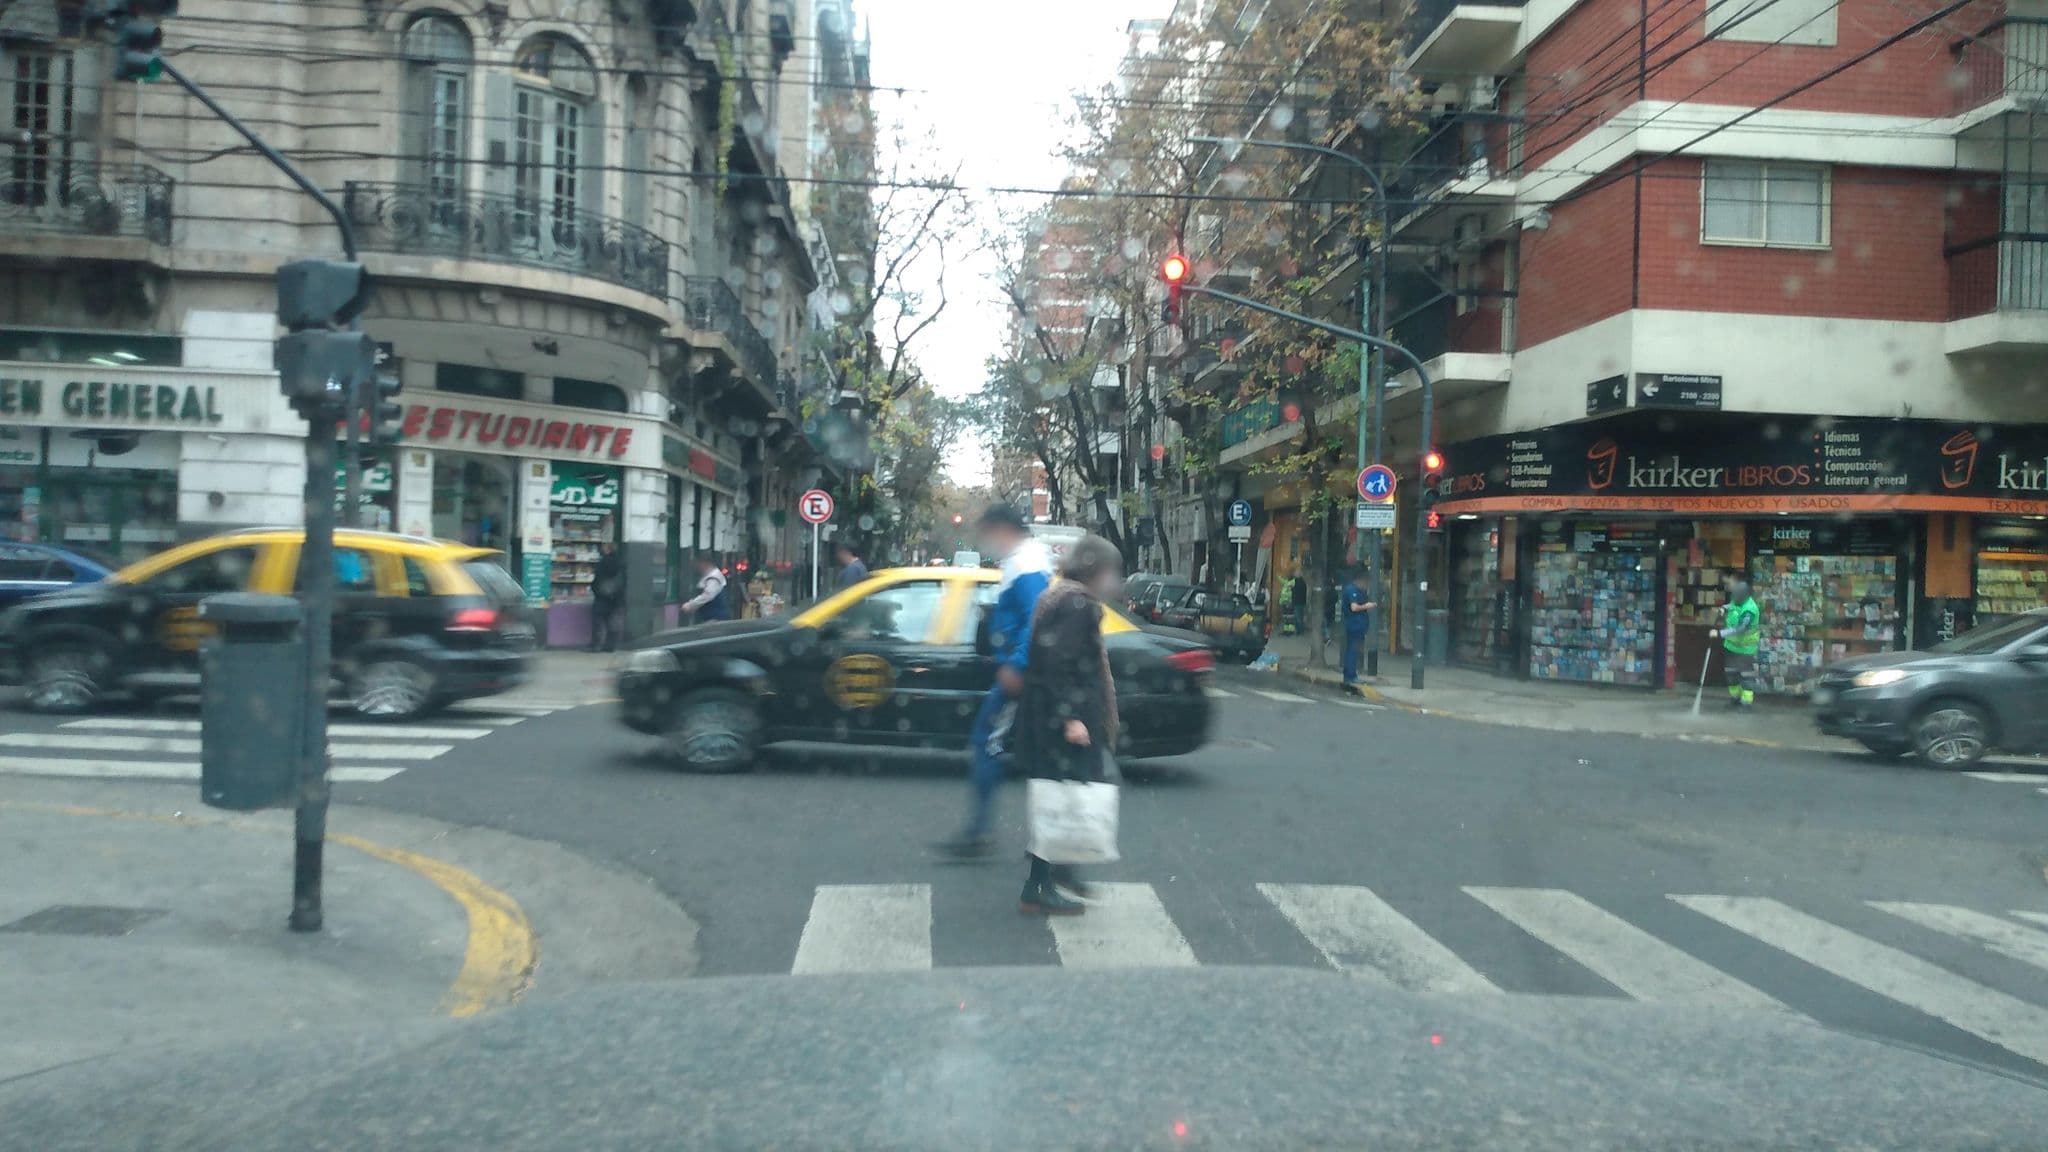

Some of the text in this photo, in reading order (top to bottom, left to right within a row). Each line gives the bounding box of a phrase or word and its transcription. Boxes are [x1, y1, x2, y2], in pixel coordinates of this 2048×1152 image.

[1700, 376, 1719, 385] Mitre
[62, 382, 223, 423] GENERAL
[402, 404, 633, 457] ESTUDIANTE
[1824, 431, 1860, 442] Idiomas
[1824, 445, 1861, 457] Técnicos
[1627, 456, 1811, 488] kirker LIBROS
[1825, 459, 1884, 474] Computación
[1824, 474, 1908, 488] Literatura general
[1521, 498, 1563, 508] COMPRA
[1584, 498, 1620, 508] VENTA
[1708, 498, 1765, 509] NUEVOS
[1773, 498, 1783, 508] Y
[1789, 497, 1850, 509] USADOS
[1773, 526, 1811, 540] kirker
